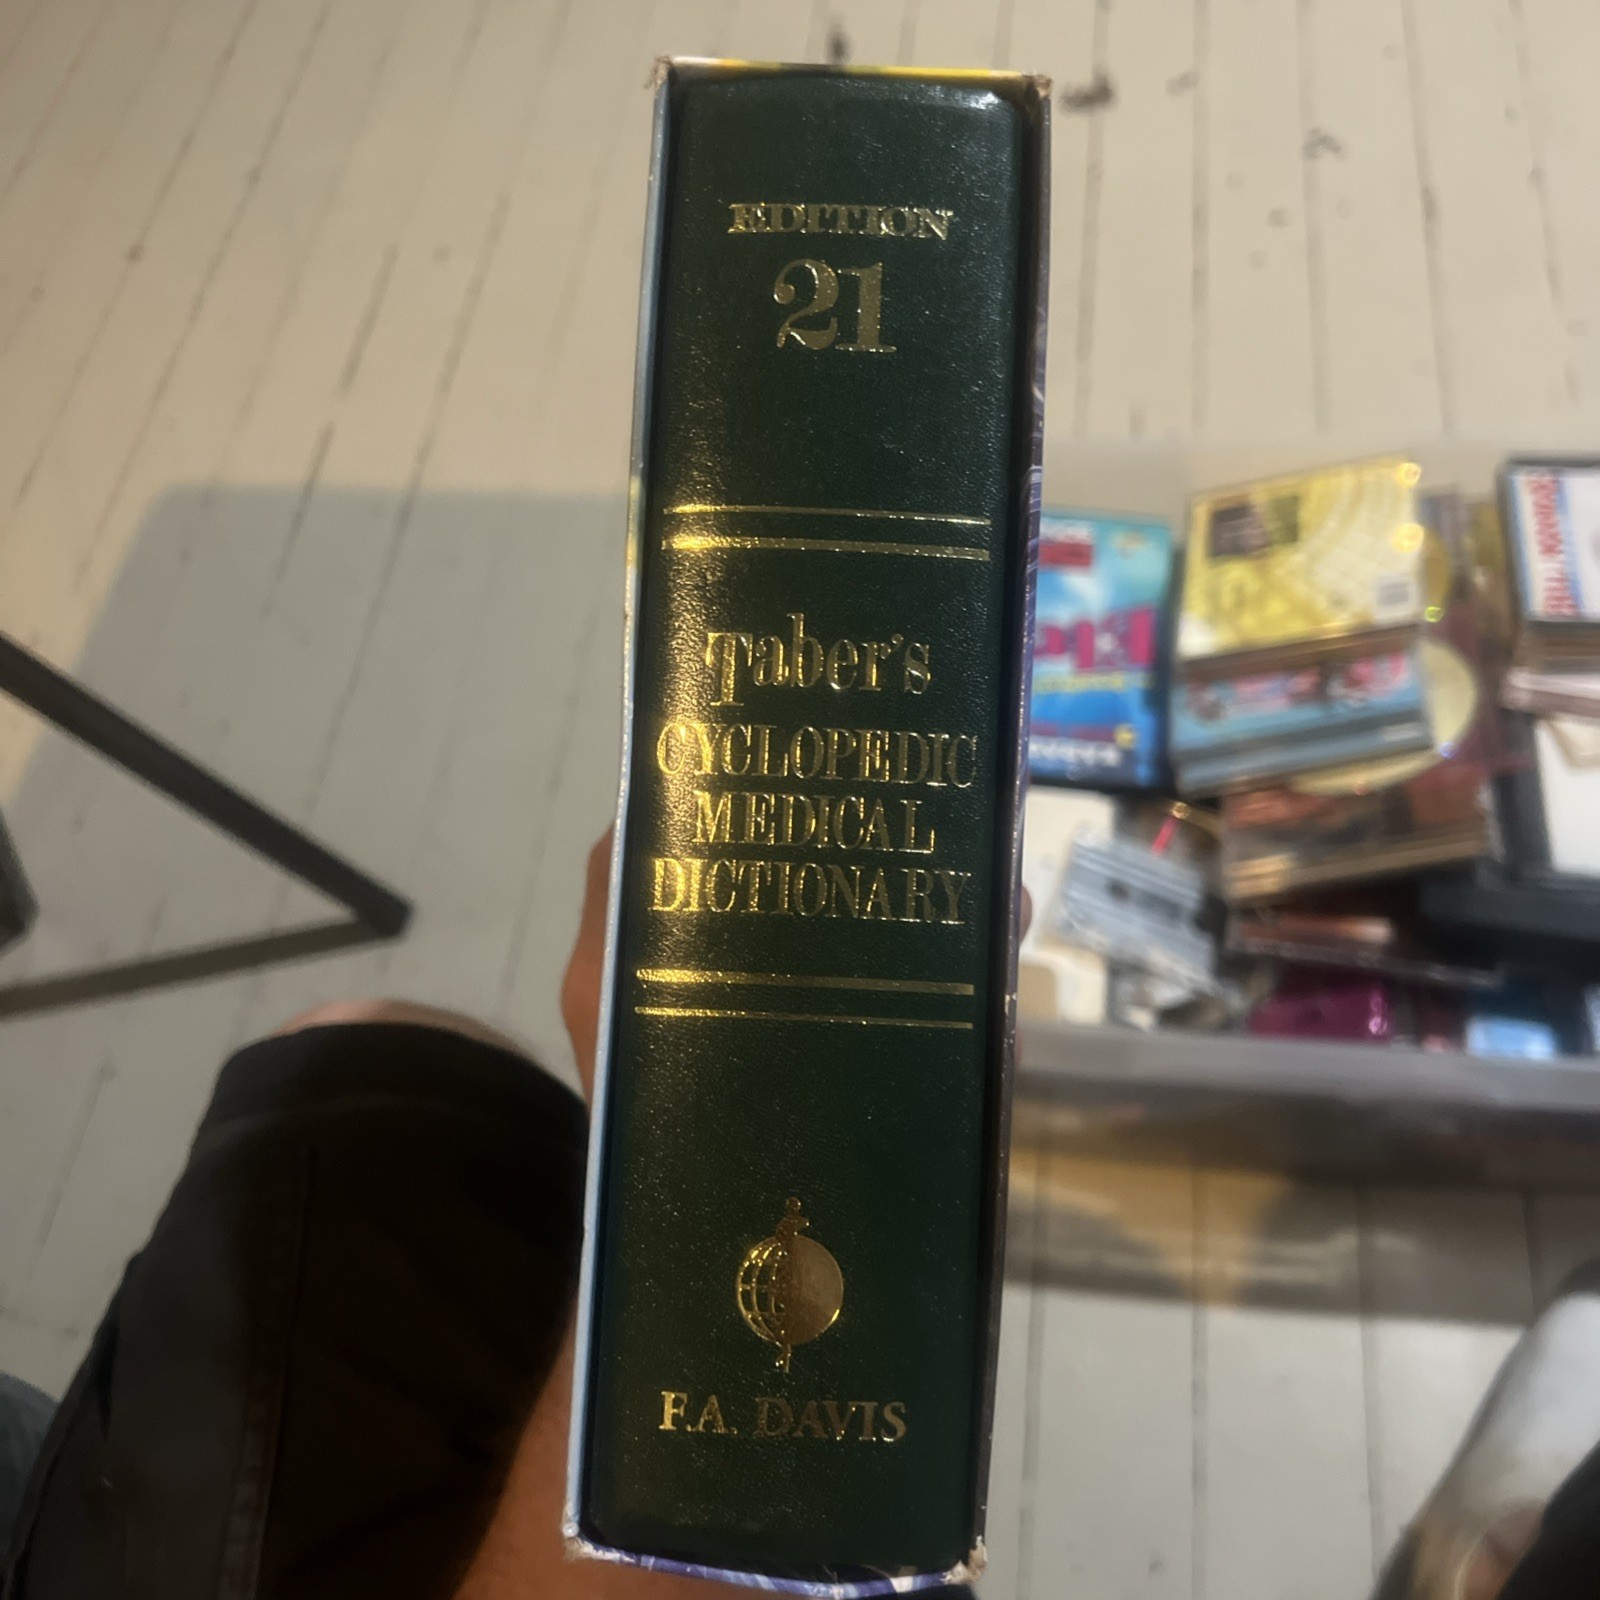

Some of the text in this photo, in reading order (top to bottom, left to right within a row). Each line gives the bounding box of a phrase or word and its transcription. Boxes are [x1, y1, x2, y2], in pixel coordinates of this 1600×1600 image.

[727, 202, 955, 240] EDITION
[773, 258, 898, 353] 21
[705, 612, 932, 707] Taber's
[656, 722, 979, 789] CYCLOPEDIC
[691, 790, 935, 854] MEDICAL
[647, 857, 972, 925] DICTIONARY
[658, 1390, 907, 1442] F.A. DAVIS
